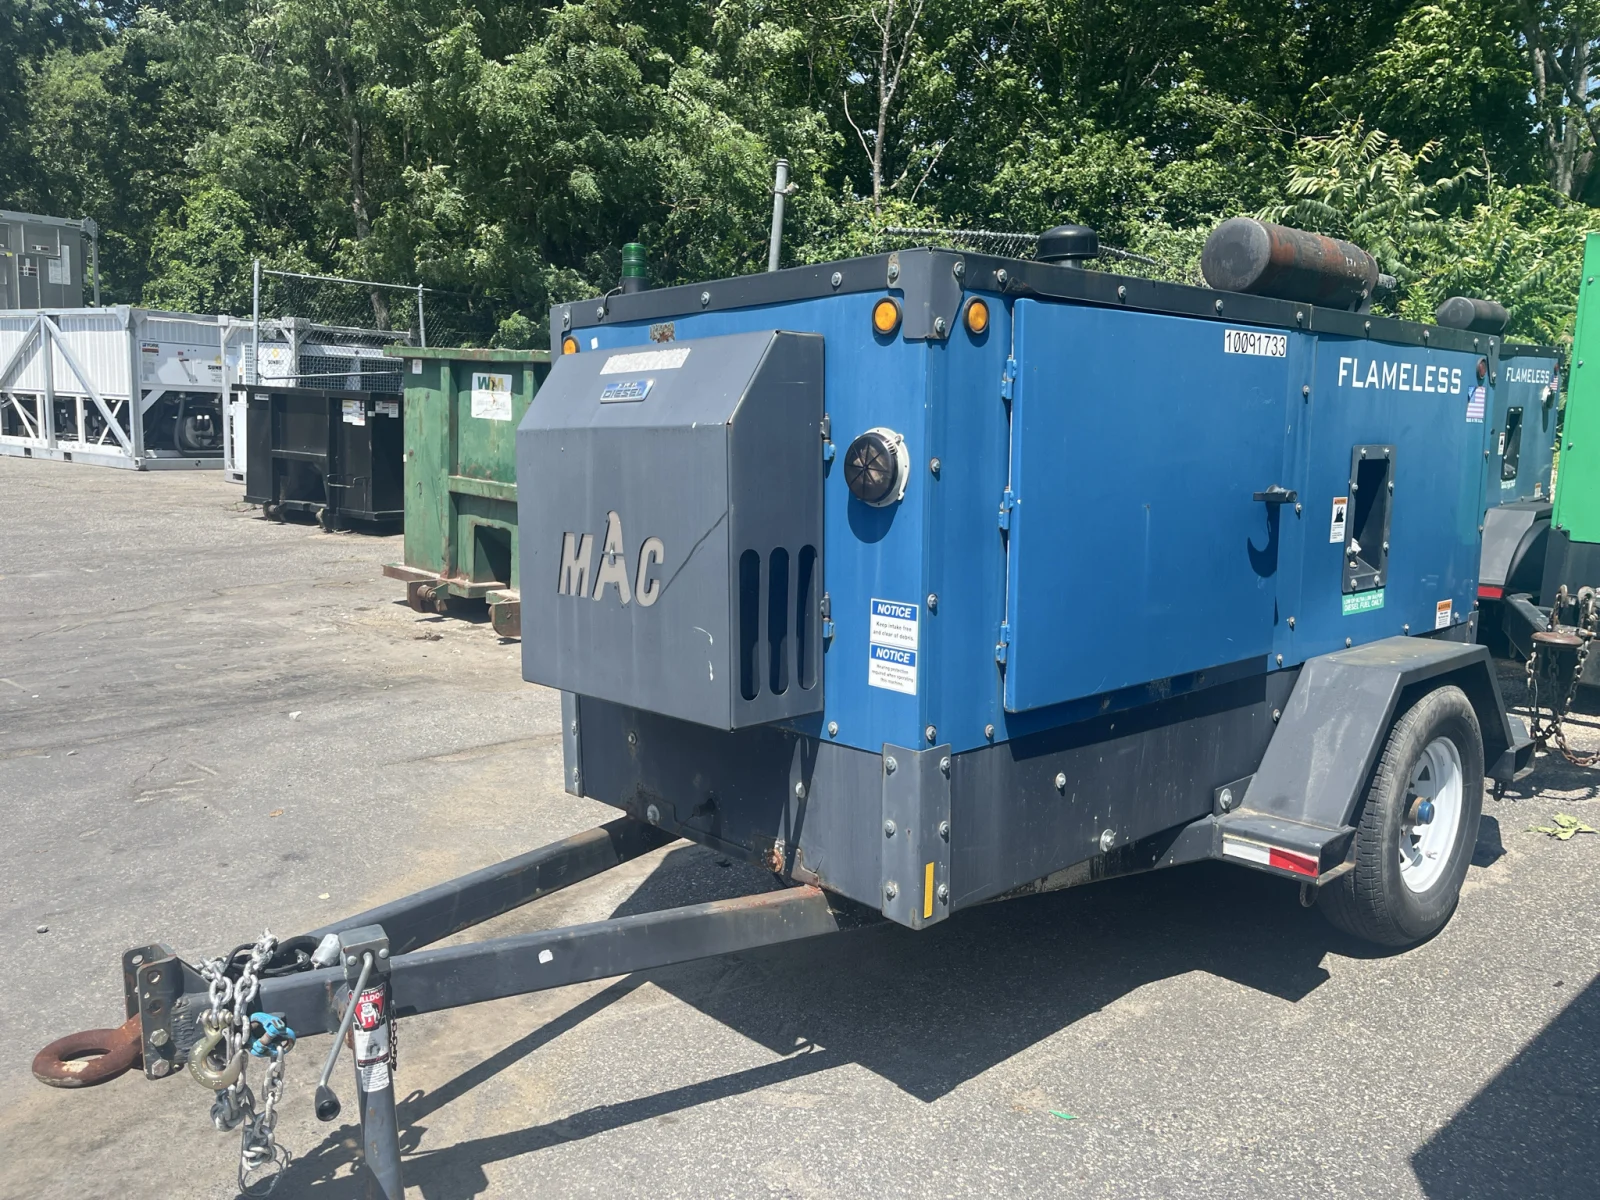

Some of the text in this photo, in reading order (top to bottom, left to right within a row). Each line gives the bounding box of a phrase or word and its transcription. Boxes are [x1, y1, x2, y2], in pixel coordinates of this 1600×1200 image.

[1226, 331, 1286, 357] 10091733
[1338, 356, 1462, 395] FLAMELESS
[1506, 366, 1550, 384] FLAMELESS
[602, 388, 643, 399] DIESEL
[557, 510, 665, 607] MAC
[877, 603, 912, 619] NOTICE
[1360, 600, 1371, 609] FUEL
[1371, 598, 1383, 607] ONLY
[876, 621, 888, 629] Keep
[888, 623, 902, 631] intake
[899, 633, 914, 641] debris.
[876, 647, 911, 664] NOTICE
